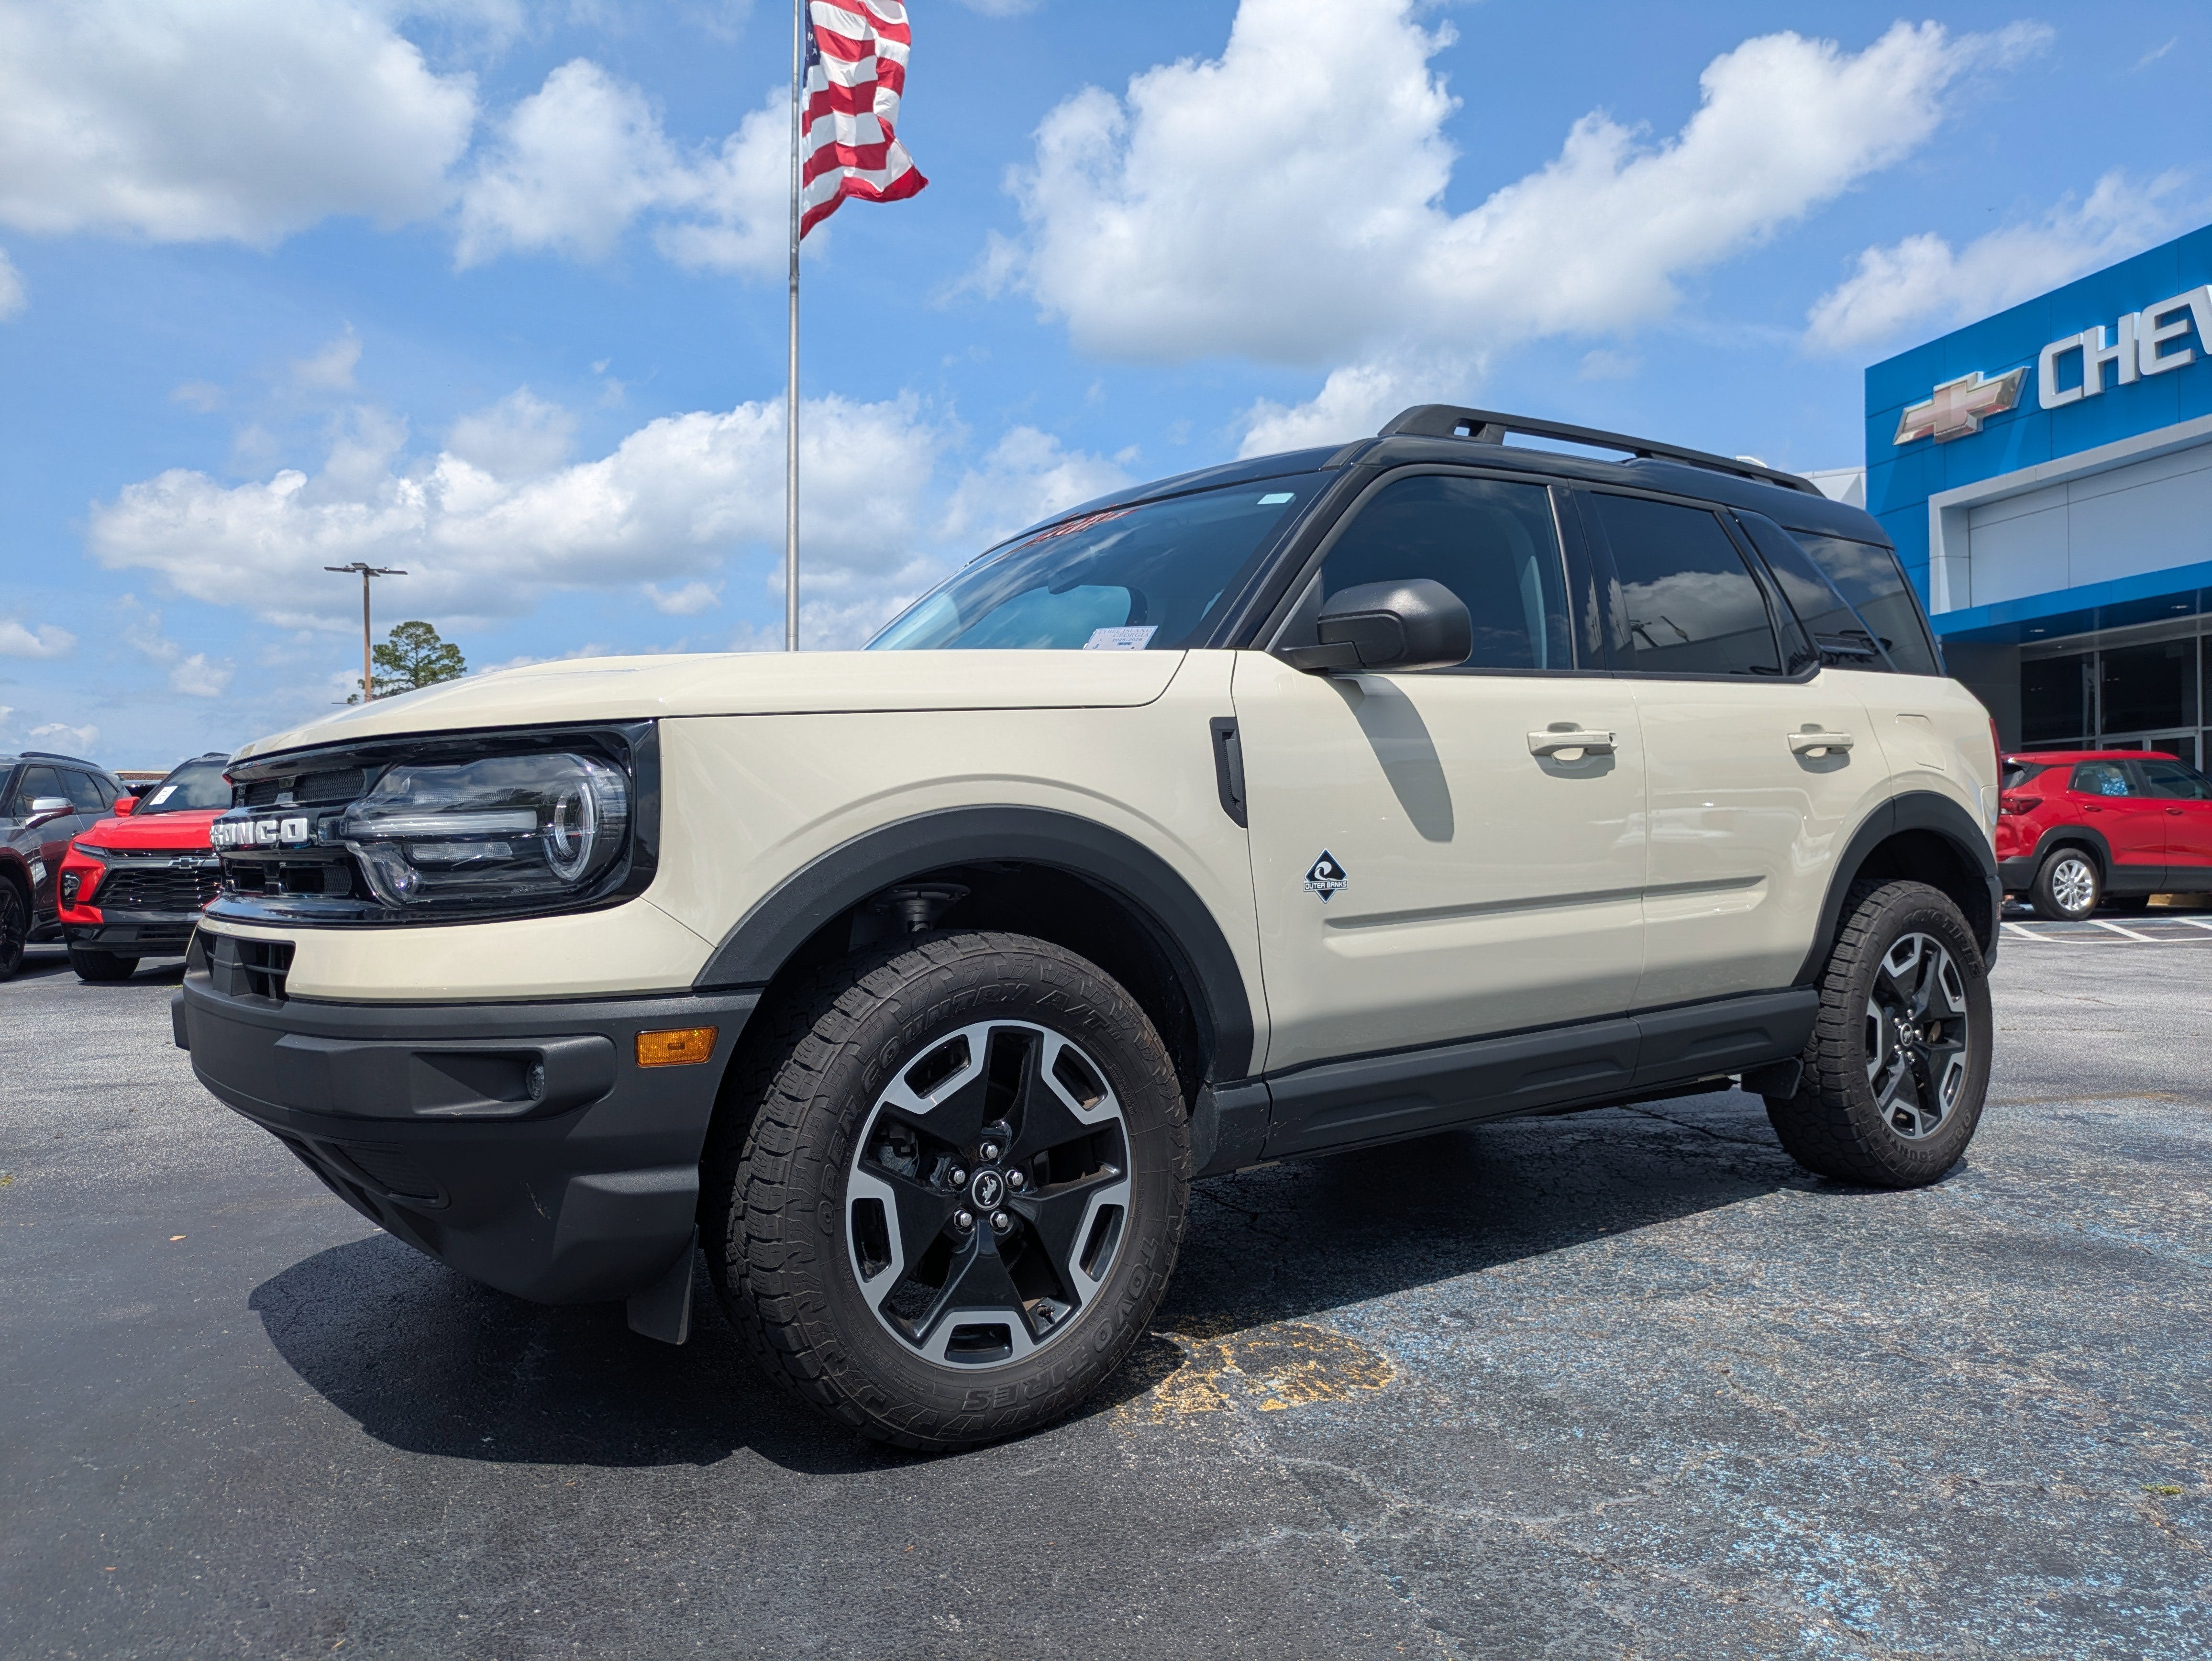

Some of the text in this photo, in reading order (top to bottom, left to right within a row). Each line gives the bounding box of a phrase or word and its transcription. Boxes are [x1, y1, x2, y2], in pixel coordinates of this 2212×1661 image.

[210, 818, 309, 846] RONCO
[818, 1095, 860, 1236] OPEN
[862, 983, 1030, 1093] COUNTRY
[1092, 1237, 1159, 1353] TOYO
[961, 1345, 1089, 1411] TIRES
